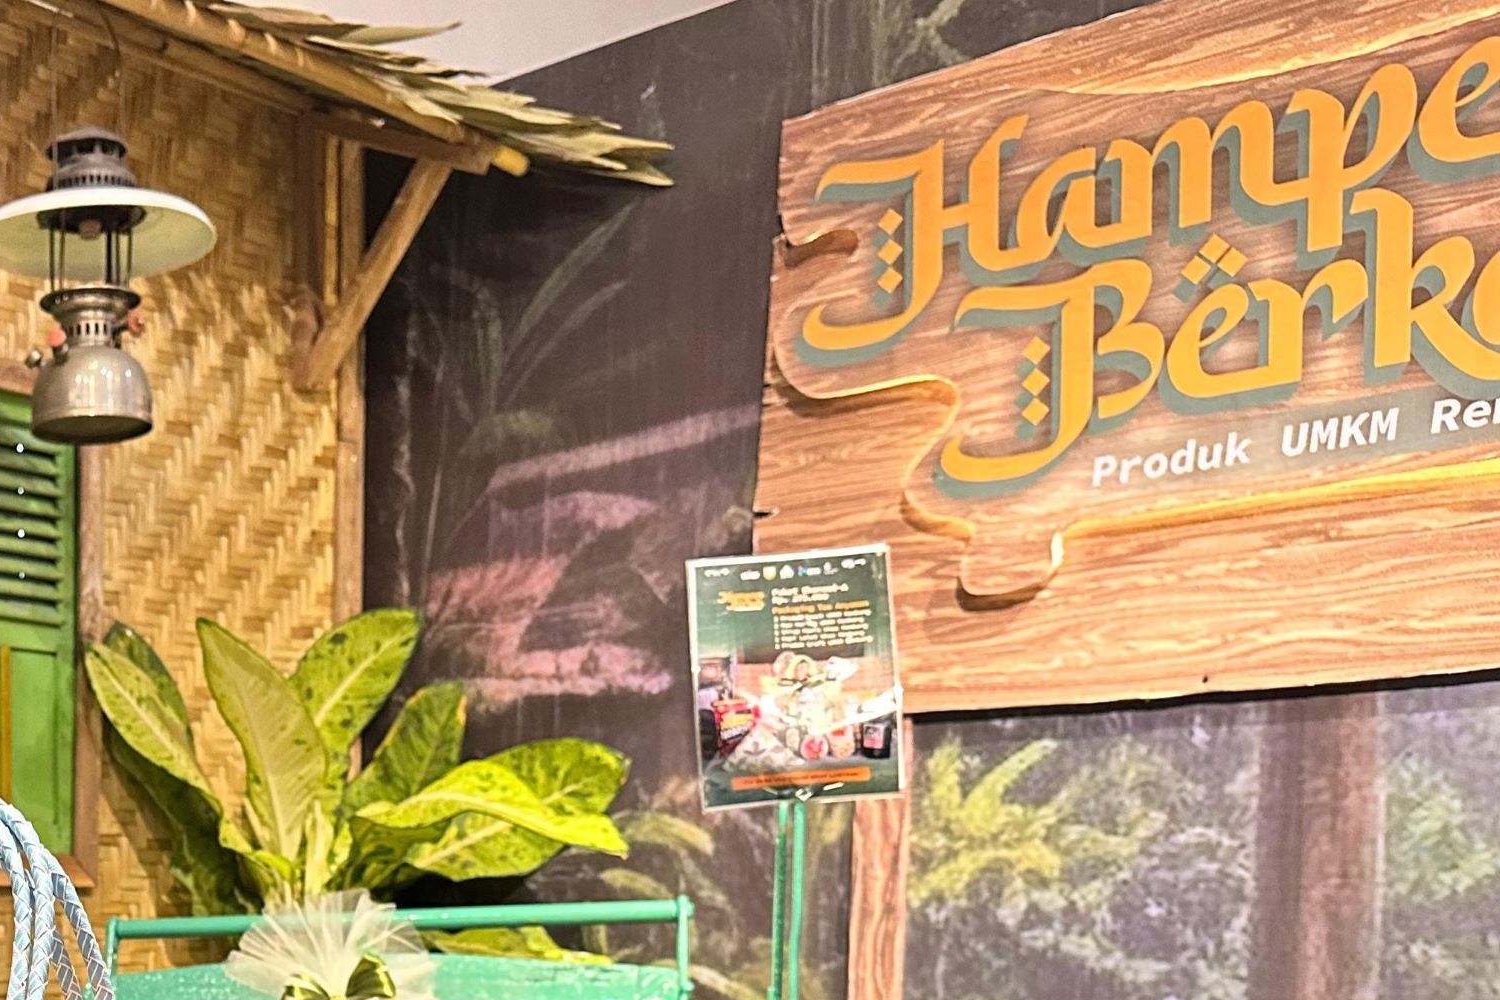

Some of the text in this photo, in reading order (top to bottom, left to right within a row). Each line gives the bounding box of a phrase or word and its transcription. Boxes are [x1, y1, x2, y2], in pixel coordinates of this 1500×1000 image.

[1091, 397, 1500, 488] Produk UMKM Re
